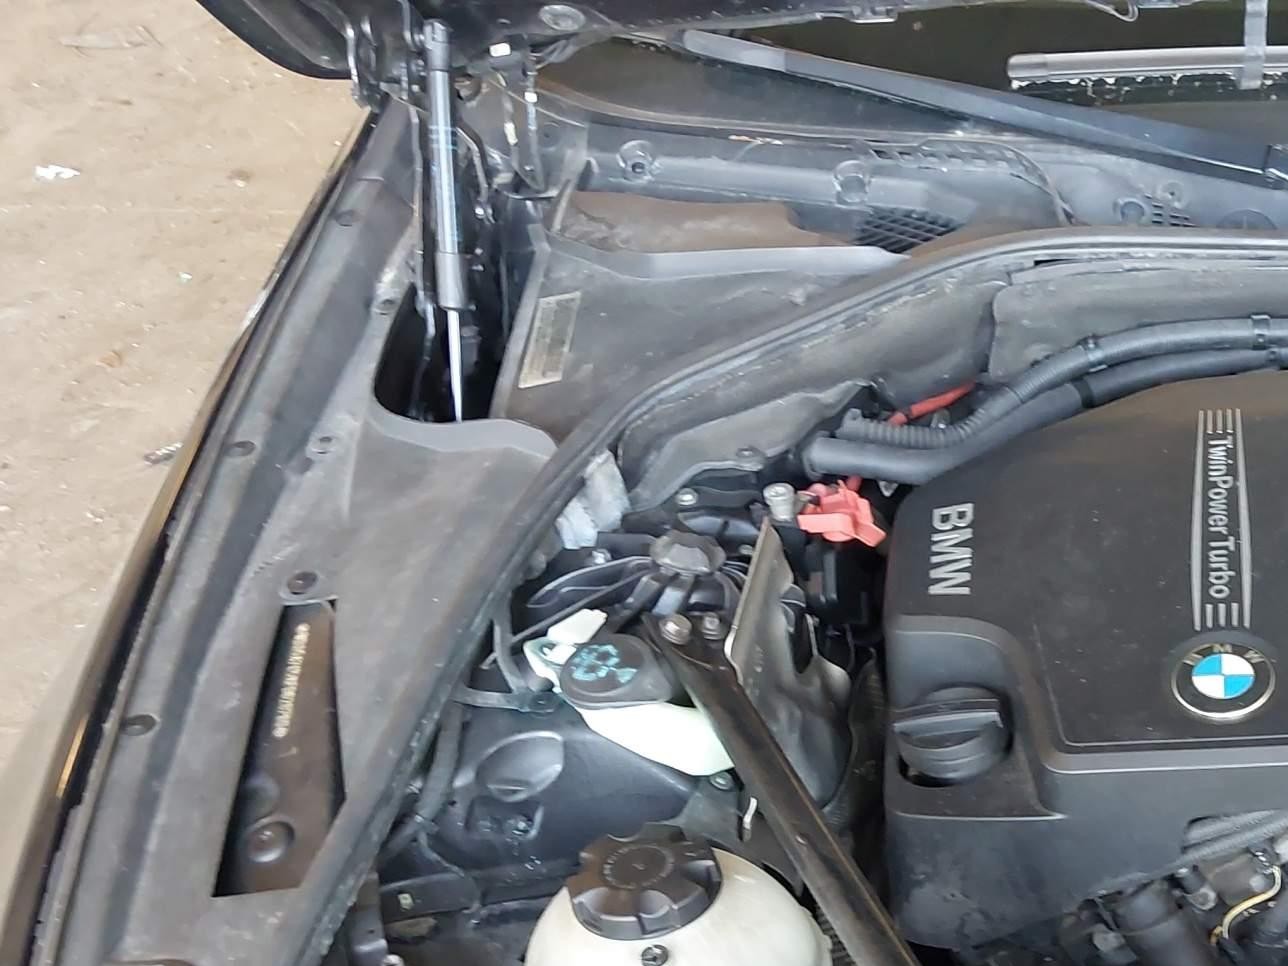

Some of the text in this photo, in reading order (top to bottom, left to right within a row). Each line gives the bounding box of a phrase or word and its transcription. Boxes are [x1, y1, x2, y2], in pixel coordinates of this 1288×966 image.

[928, 501, 974, 595] BMW
[1207, 435, 1237, 599] TwinPower Turbo
